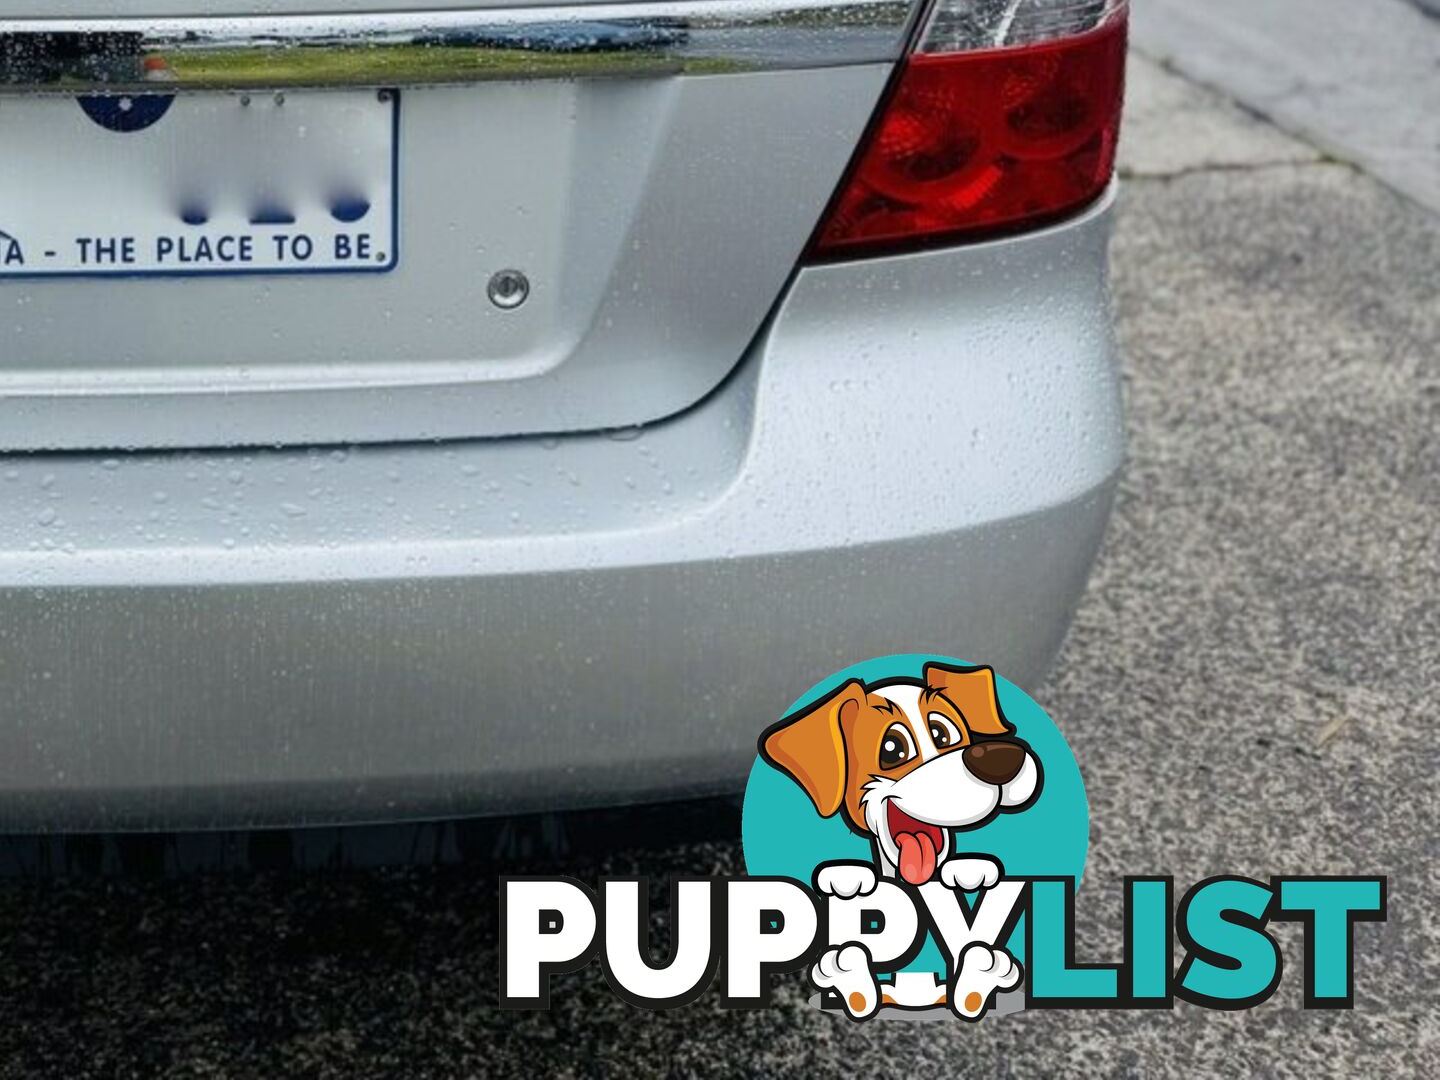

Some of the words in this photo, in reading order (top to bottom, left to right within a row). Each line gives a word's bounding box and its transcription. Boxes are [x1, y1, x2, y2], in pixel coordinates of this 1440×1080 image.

[75, 237, 135, 264] THE
[156, 235, 253, 262] PLACE
[272, 234, 314, 261] TO
[334, 233, 371, 260] BE
